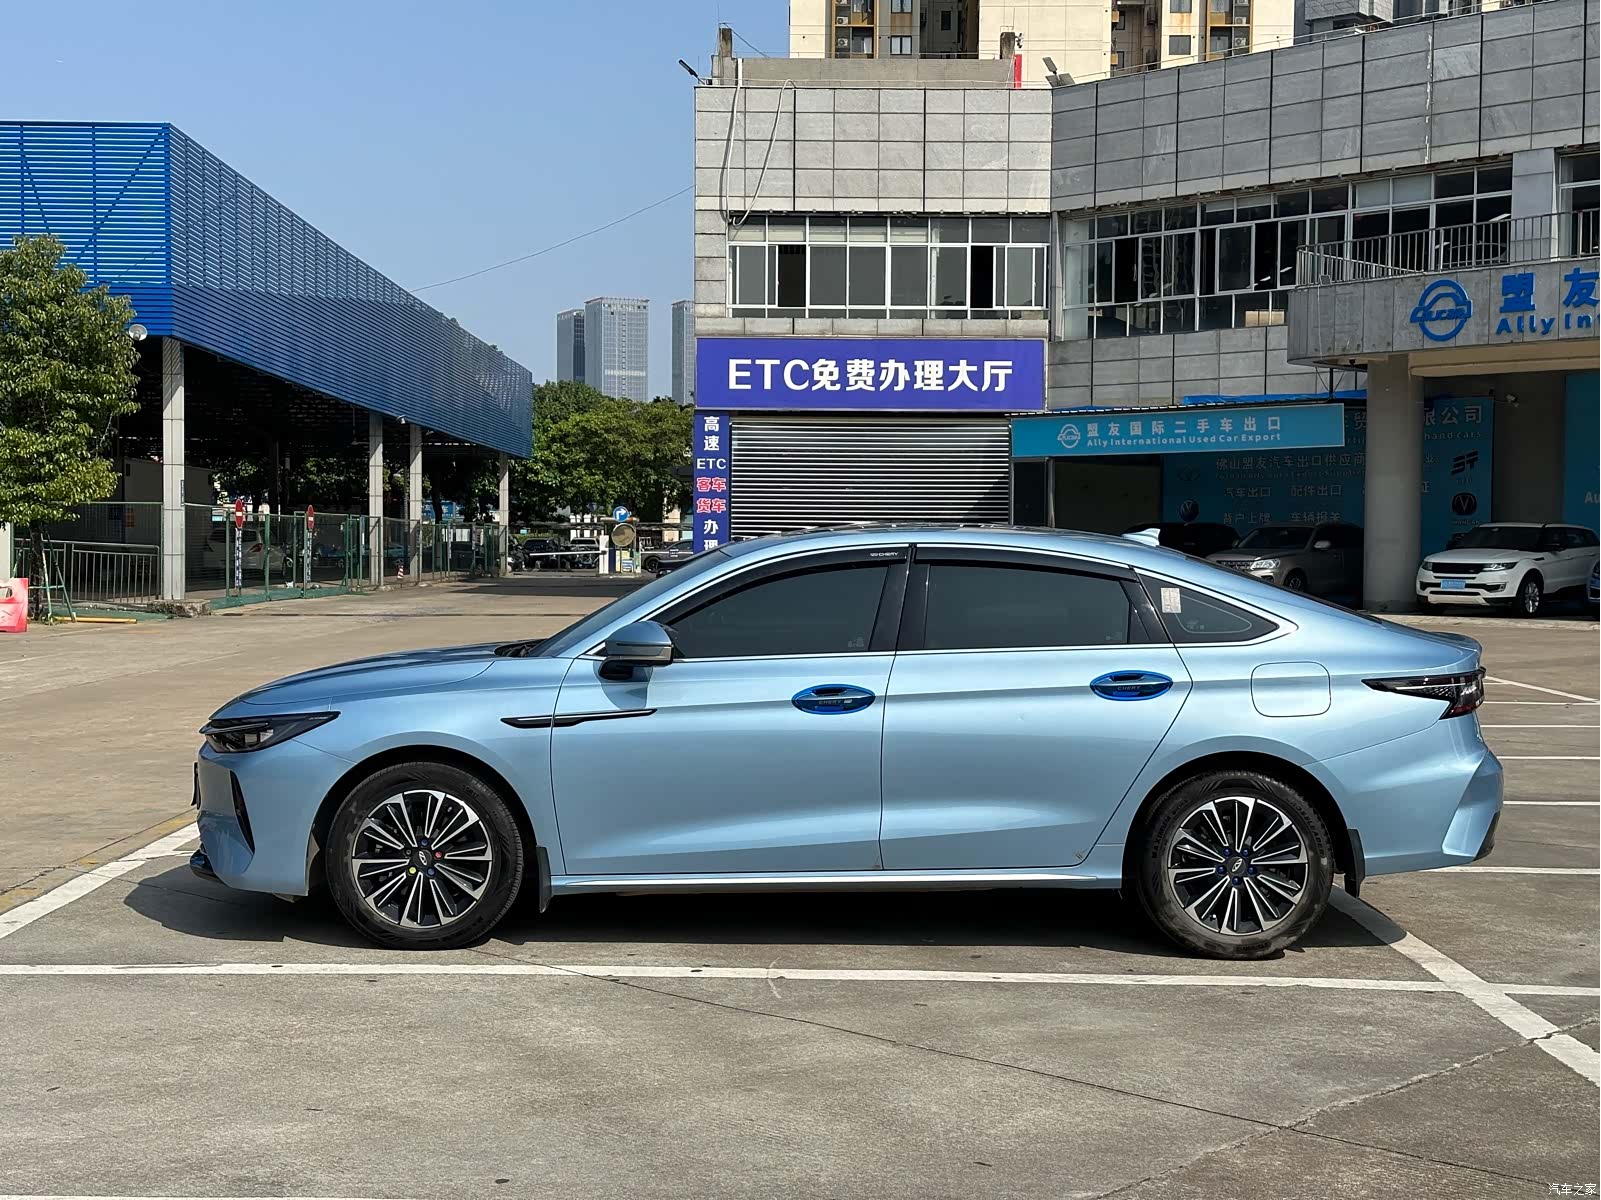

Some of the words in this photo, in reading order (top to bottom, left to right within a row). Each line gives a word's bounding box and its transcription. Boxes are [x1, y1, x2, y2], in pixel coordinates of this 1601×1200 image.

[1500, 267, 1600, 312] 盟友
[1496, 315, 1555, 335] Ally
[1564, 312, 1600, 330] In
[728, 358, 1013, 392] ETC免费办理大厅
[704, 416, 719, 450] 高速
[1087, 416, 1280, 437] 盟友国际二手车出口
[1087, 439, 1108, 448] Ally
[1111, 436, 1186, 446] International
[1189, 435, 1216, 444] Used
[1219, 434, 1239, 442] Car
[1241, 432, 1281, 442] Export
[697, 458, 726, 469] ETC
[697, 477, 726, 492] 客车
[697, 498, 726, 513] 货车
